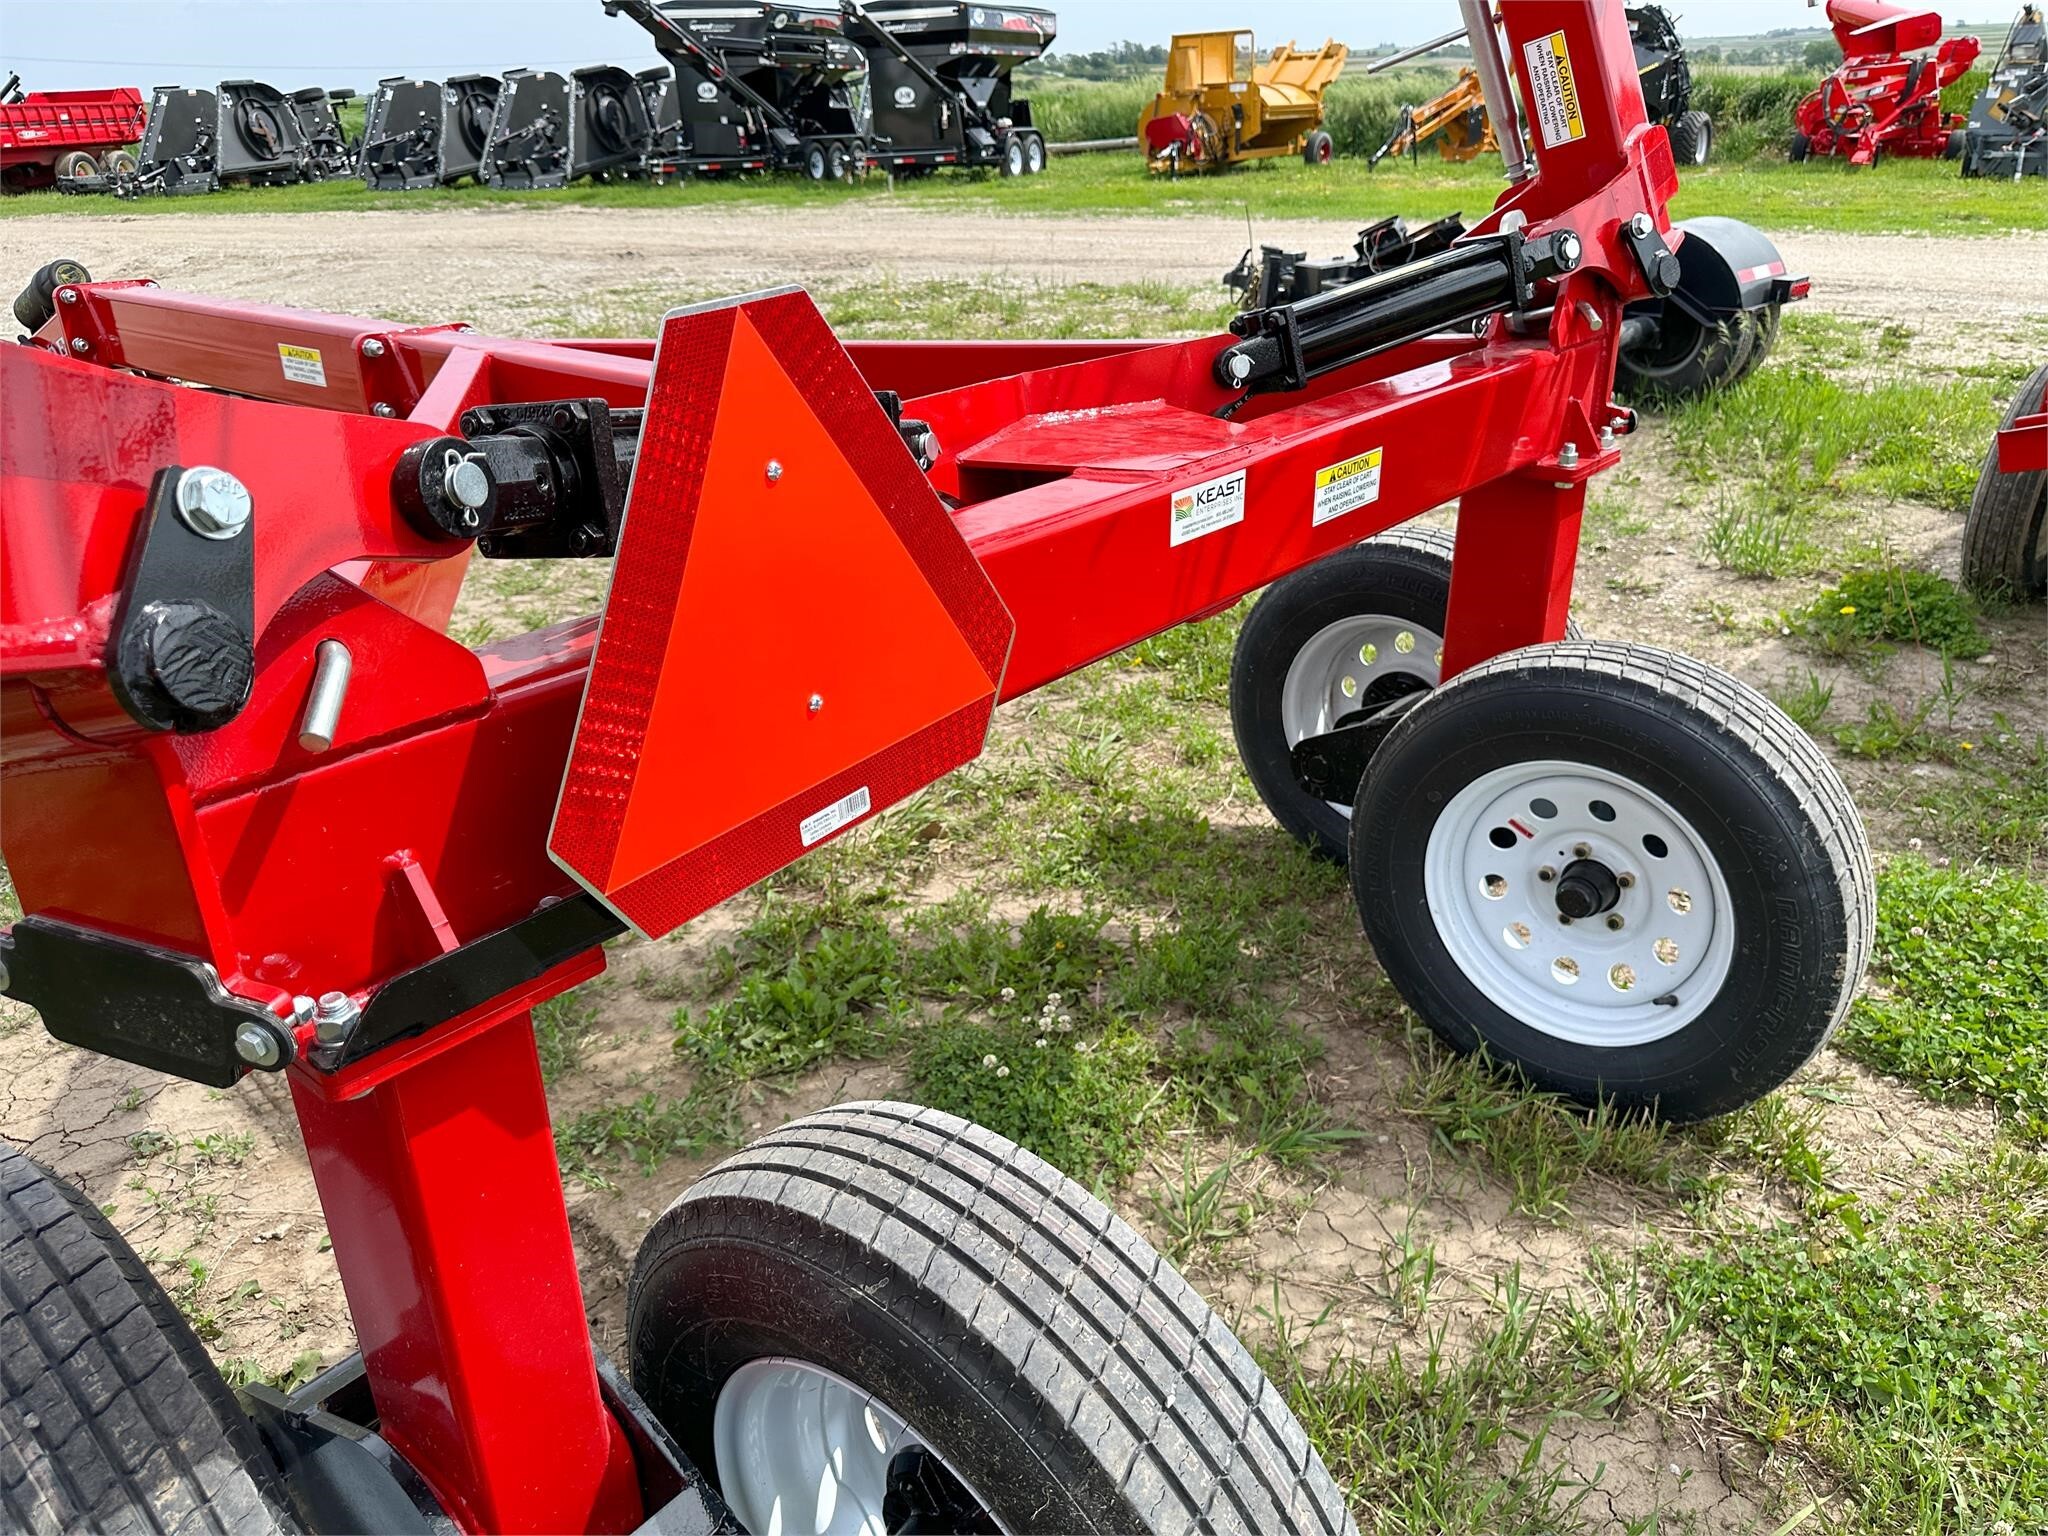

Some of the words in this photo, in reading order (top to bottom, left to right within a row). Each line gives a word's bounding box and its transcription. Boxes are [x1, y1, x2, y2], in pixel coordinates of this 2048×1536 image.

[1545, 50, 1555, 68] STAY
[1532, 65, 1541, 82] AND
[1550, 70, 1560, 95] CLEAR
[1536, 43, 1546, 67] WHEN
[1541, 68, 1553, 101] RAISING,
[1548, 101, 1562, 141] LOWERING
[1536, 83, 1550, 125] OPERATING
[1556, 96, 1562, 107] OF
[1558, 66, 1577, 120] CAUTION
[1558, 108, 1567, 128] CART
[1337, 456, 1370, 478] CAUTION
[1197, 477, 1244, 507] KEAST
[1317, 497, 1332, 508] WHEN
[1332, 489, 1352, 502] RAISING,
[1353, 478, 1377, 494] LOWERING
[1324, 485, 1336, 495] STAY
[1336, 479, 1352, 490] CLEAR
[1353, 475, 1359, 484] OF
[1360, 471, 1372, 481] CART
[1196, 496, 1233, 516] ENTERPRISES
[1328, 503, 1339, 514] AND
[1339, 493, 1365, 509] OPERATING
[1762, 897, 1802, 1034] RAINIER
